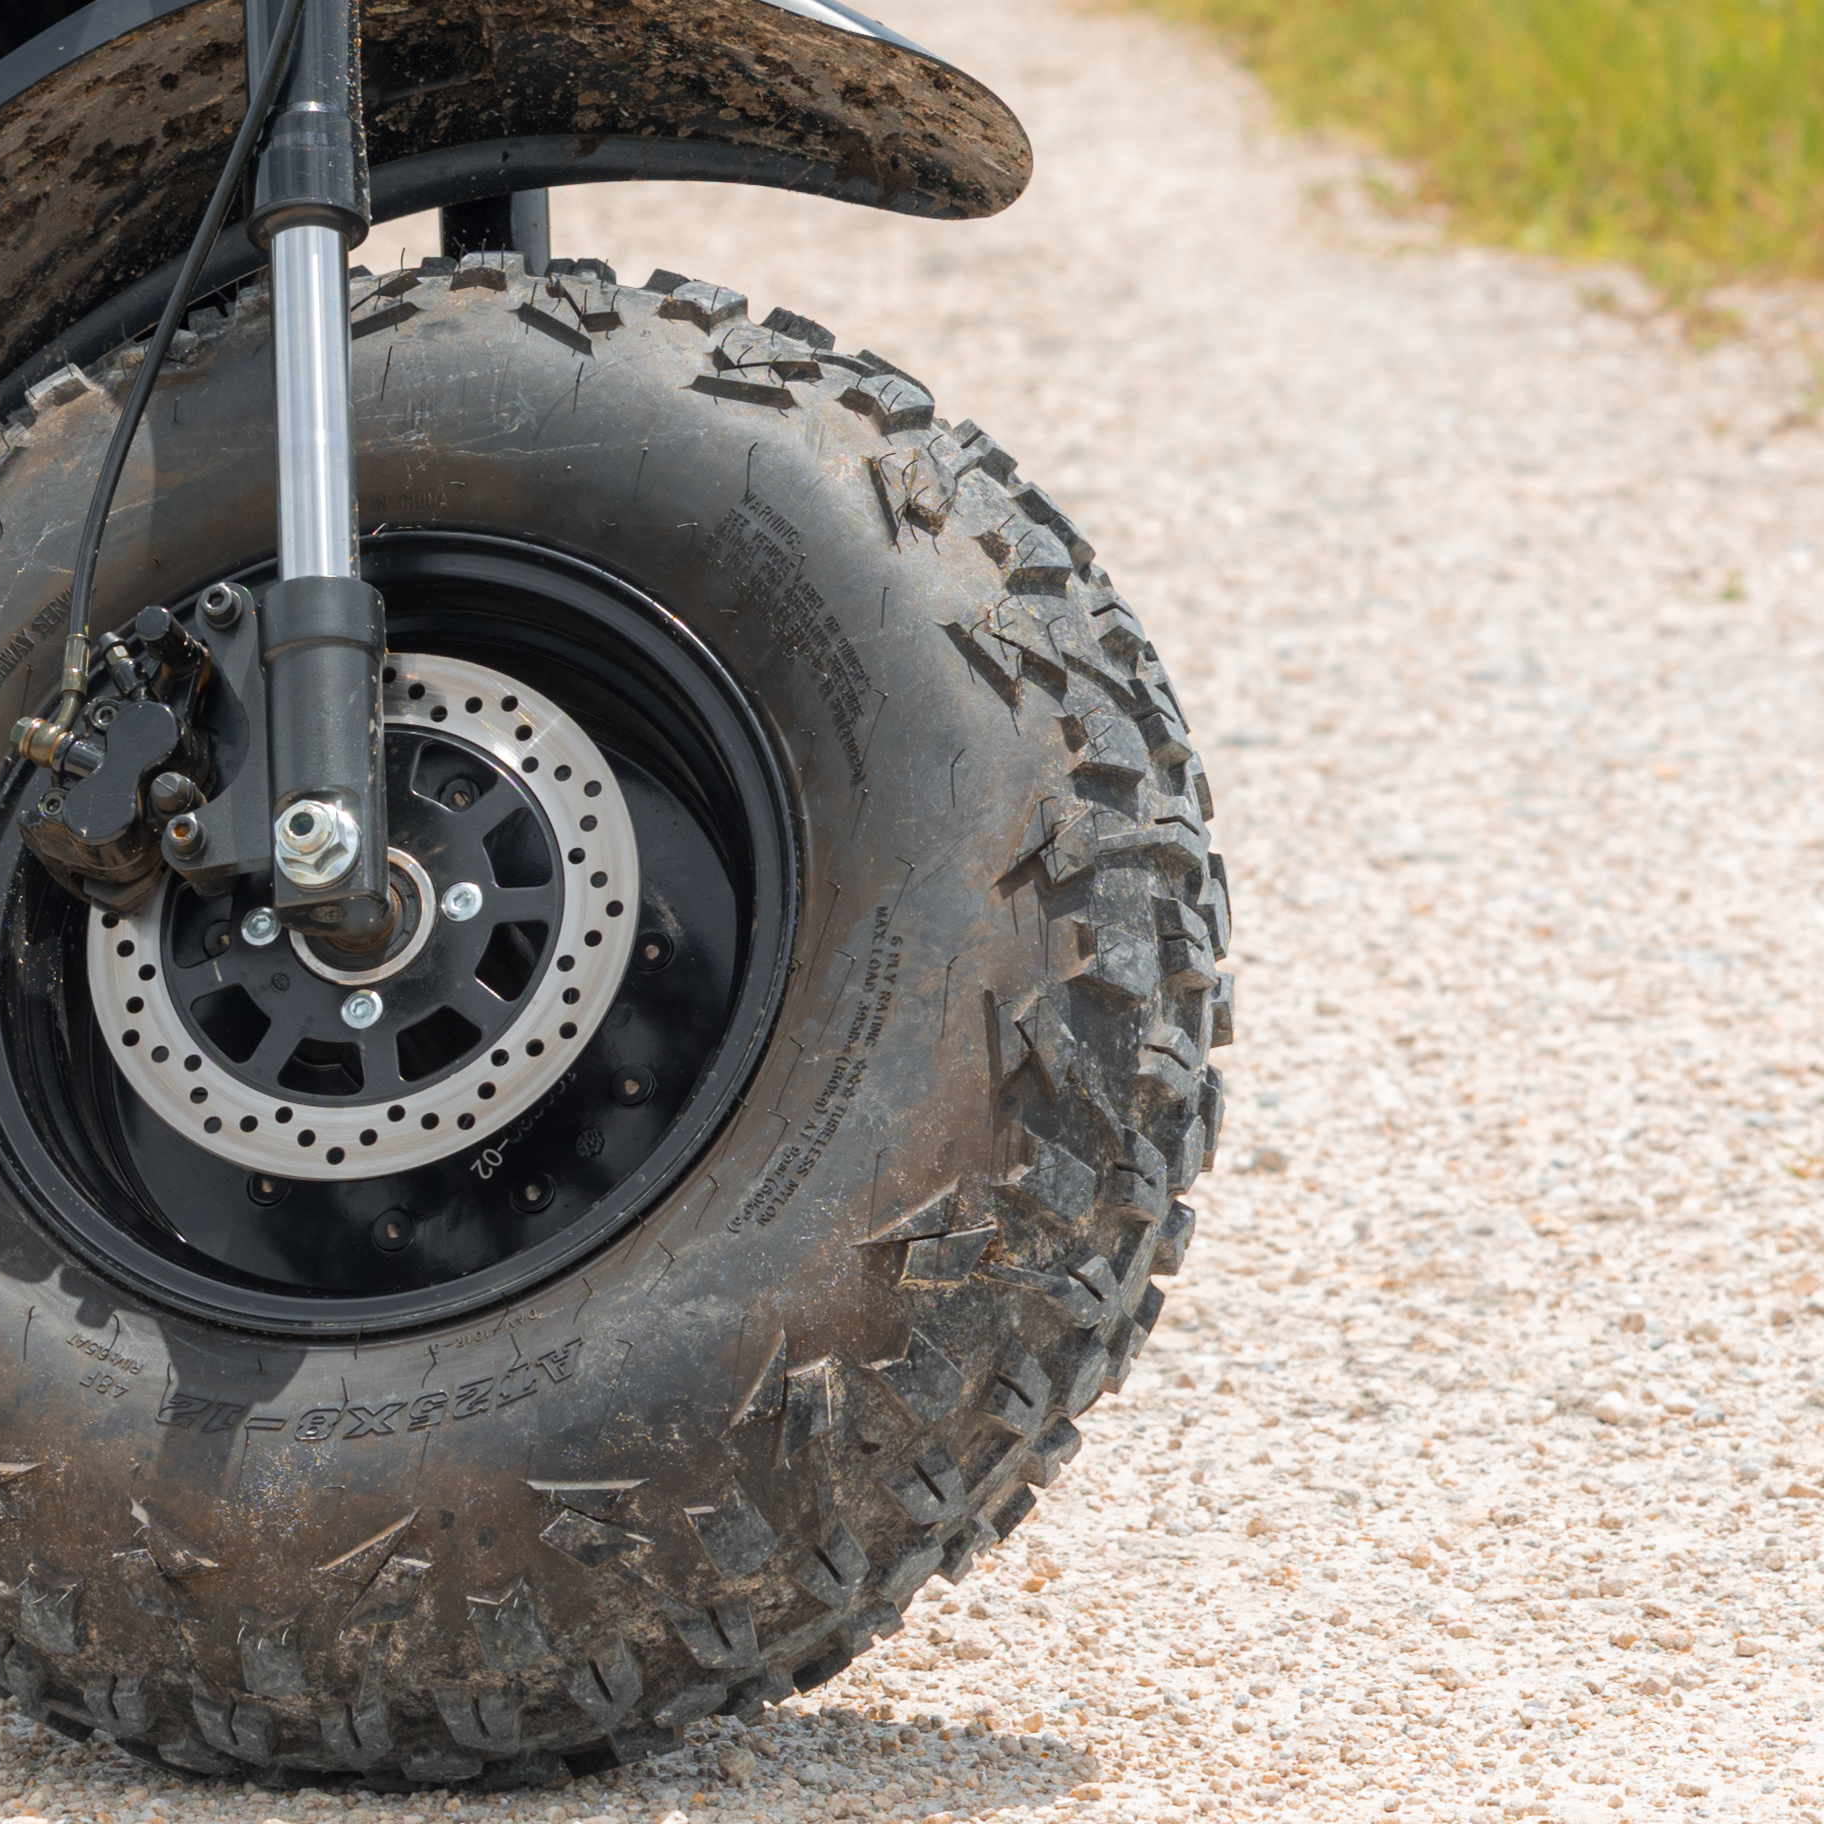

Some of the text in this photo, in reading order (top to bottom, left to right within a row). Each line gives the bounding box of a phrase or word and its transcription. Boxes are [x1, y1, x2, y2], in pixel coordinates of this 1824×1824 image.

[400, 492, 448, 510] CHINA
[714, 519, 761, 562] MANUAL
[724, 507, 751, 531] SEE
[749, 527, 797, 574] VEHICLE
[792, 572, 827, 613] LABEL
[823, 612, 842, 635] OR
[863, 947, 882, 994] LOAD
[880, 951, 900, 984] PLY
[863, 989, 892, 1050] RATING
[794, 1104, 848, 1178] TUBELESS
[797, 1118, 816, 1140] AT
[754, 1180, 800, 1227] NYLON
[79, 1371, 129, 1399] 48F
[155, 1336, 585, 1441] AT25X8-12
